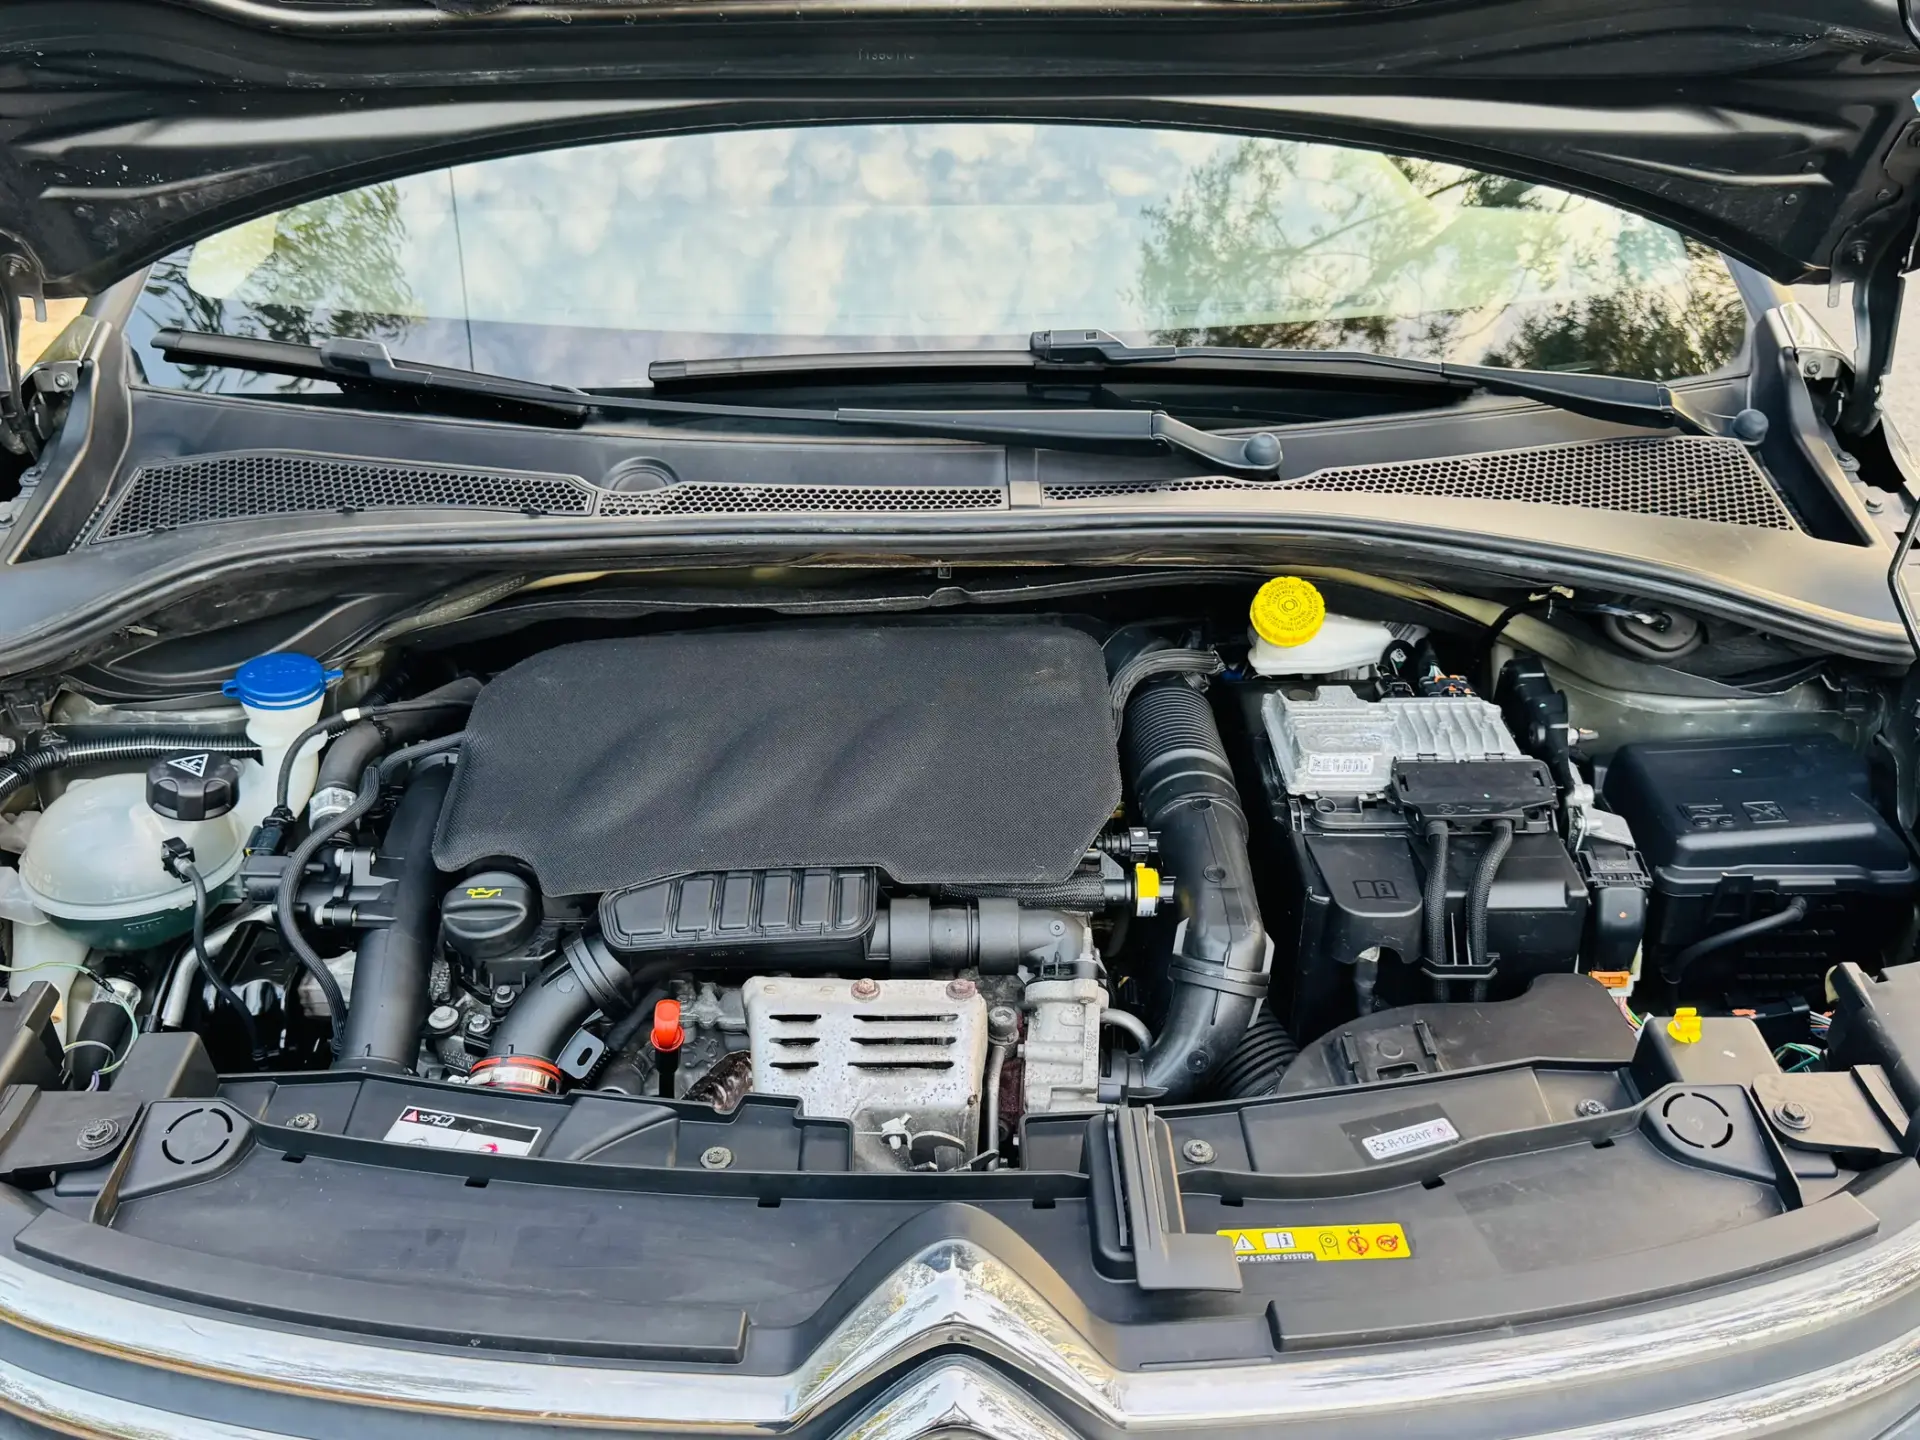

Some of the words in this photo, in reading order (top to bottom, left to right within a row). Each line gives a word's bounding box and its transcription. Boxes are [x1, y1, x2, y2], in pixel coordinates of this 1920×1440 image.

[1387, 1129, 1432, 1149] R-1234YF
[1256, 1254, 1281, 1262] START
[1283, 1253, 1314, 1261] SYSTEM
